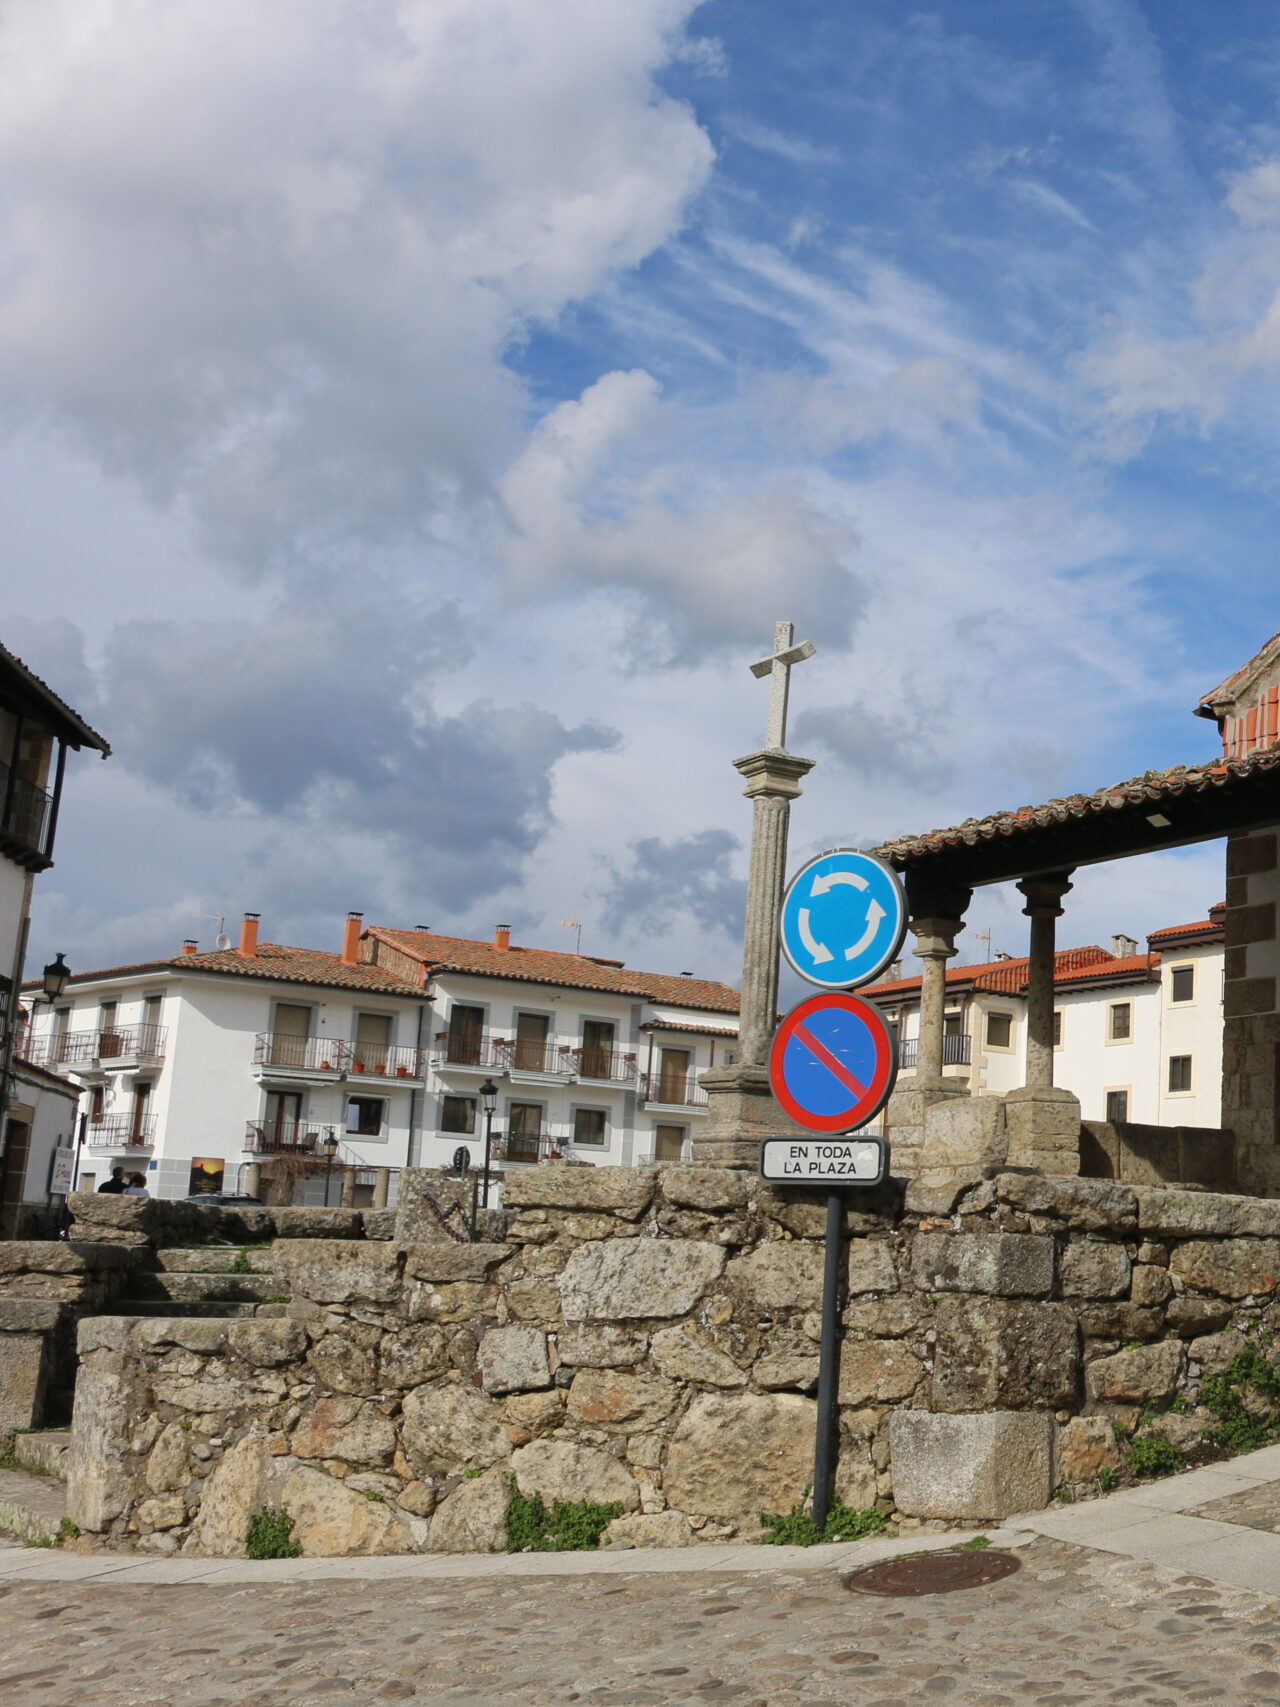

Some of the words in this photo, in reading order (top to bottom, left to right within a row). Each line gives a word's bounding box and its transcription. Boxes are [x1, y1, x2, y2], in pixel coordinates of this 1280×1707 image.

[790, 1146, 809, 1158] EN
[815, 1146, 852, 1159] TODA
[784, 1162, 802, 1174] LA
[809, 1162, 857, 1175] PLAZA
